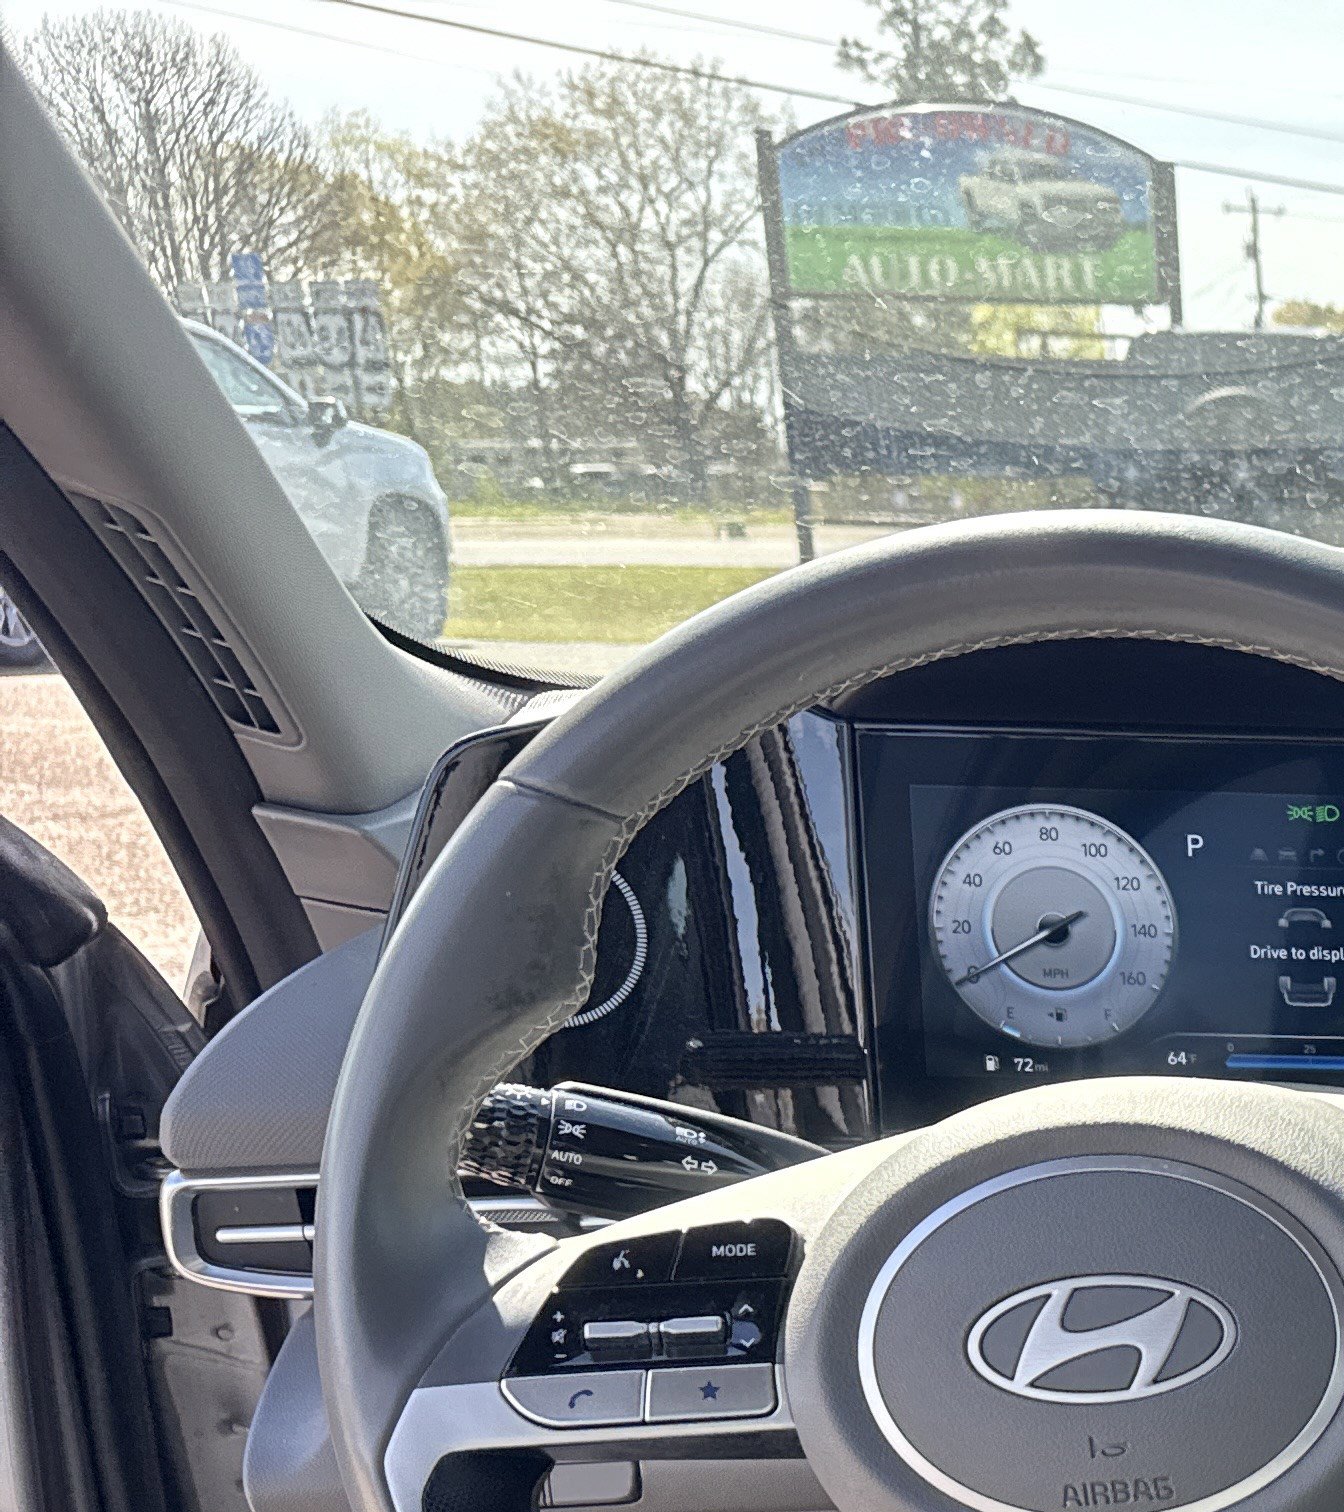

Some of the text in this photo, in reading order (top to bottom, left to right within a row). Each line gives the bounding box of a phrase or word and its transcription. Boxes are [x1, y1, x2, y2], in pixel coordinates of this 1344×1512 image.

[1039, 826, 1059, 841] 80
[993, 841, 1013, 856] 60
[1082, 843, 1108, 858] 100
[1187, 834, 1204, 857] P
[963, 873, 983, 887] 40
[1115, 876, 1141, 891] 120
[1254, 880, 1283, 895] Tire
[952, 920, 972, 934] 20
[1131, 923, 1158, 938] 140
[1250, 945, 1288, 960] Drive
[1291, 946, 1306, 960] to
[1043, 968, 1069, 979] MPH
[1120, 971, 1147, 986] 160
[1006, 1006, 1015, 1019] E
[1104, 1007, 1113, 1020] F
[551, 1149, 583, 1165] AUTO
[550, 1175, 574, 1187] OFF
[711, 1241, 757, 1258] MODE
[1061, 1474, 1176, 1510] AIRBAG
